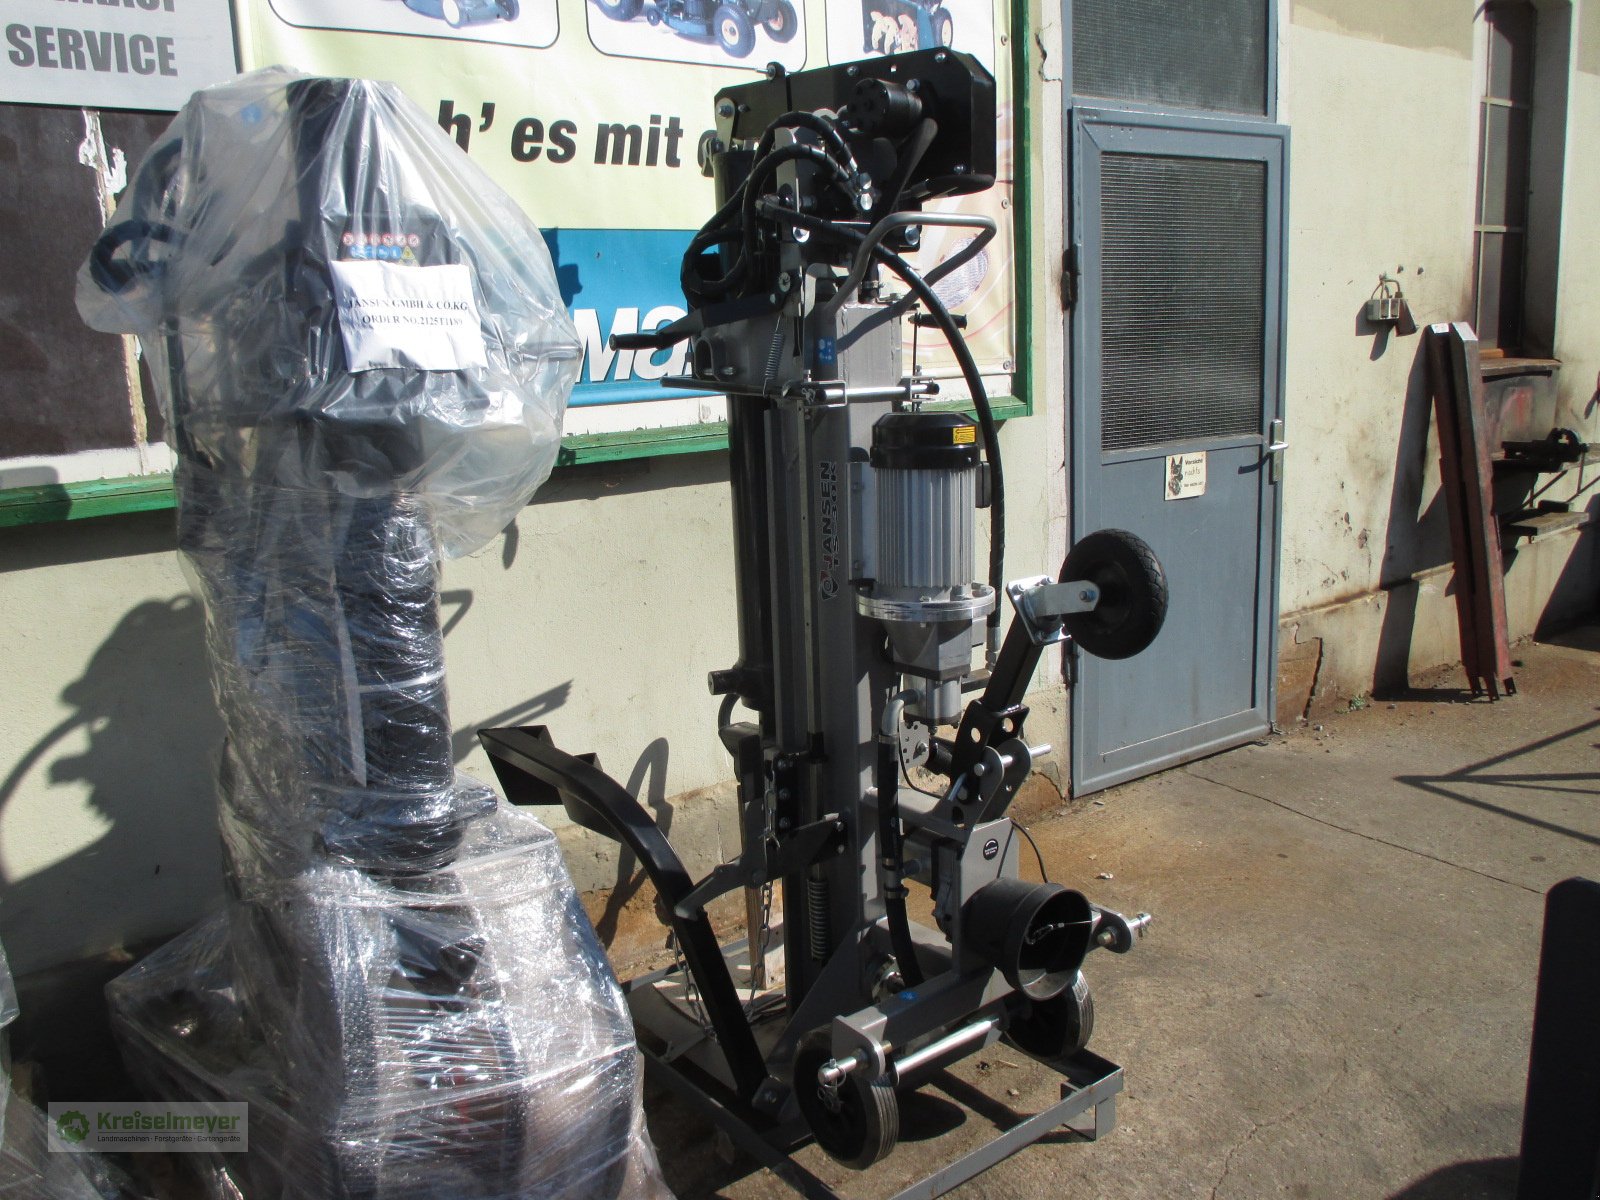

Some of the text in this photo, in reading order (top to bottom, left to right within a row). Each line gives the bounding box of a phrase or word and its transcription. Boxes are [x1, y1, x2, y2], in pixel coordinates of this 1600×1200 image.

[6, 23, 178, 76] SERVICE
[511, 117, 578, 163] es
[594, 114, 684, 167] mit
[362, 314, 400, 325] ORDER
[392, 299, 424, 309] GMBH
[427, 300, 434, 309] &
[573, 305, 694, 382] Ma
[821, 462, 833, 570] JANSEN
